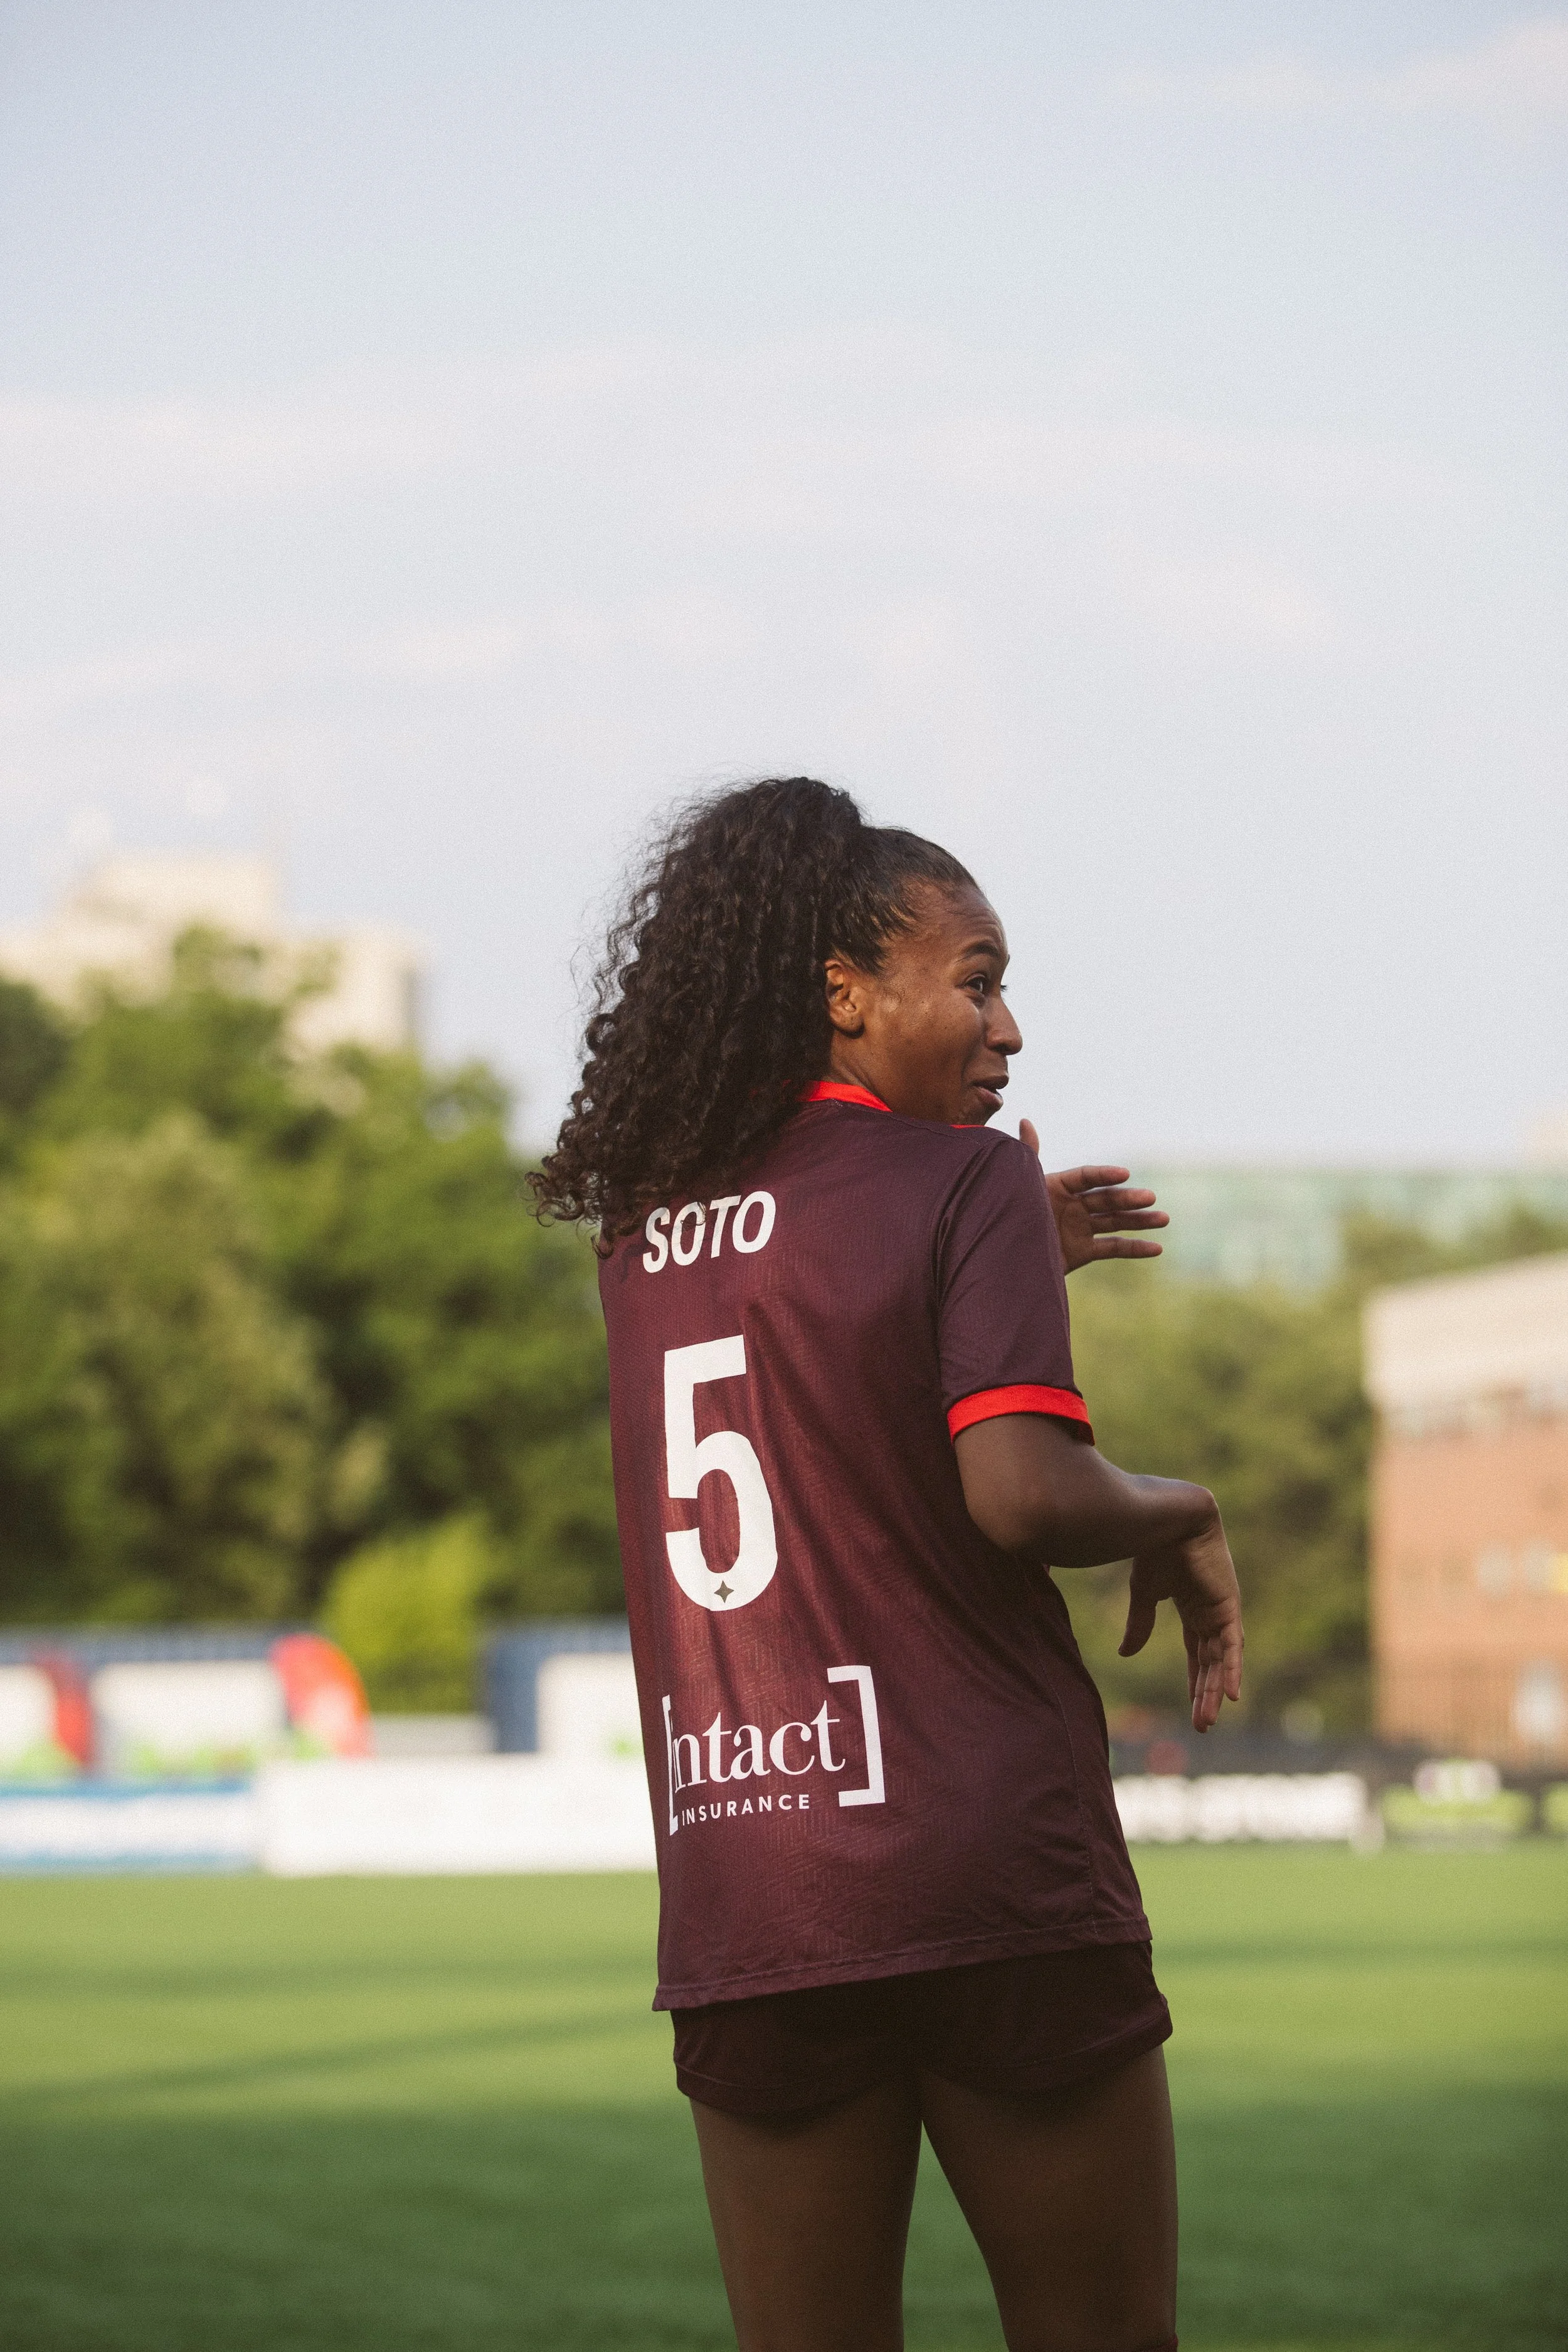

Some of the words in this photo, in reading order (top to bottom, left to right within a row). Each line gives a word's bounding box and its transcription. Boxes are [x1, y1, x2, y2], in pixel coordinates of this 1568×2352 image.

[642, 1190, 776, 1273] SOTO
[664, 1334, 778, 1611] 5
[670, 1700, 845, 1793] ntact
[682, 1794, 810, 1826] INSURANCE
